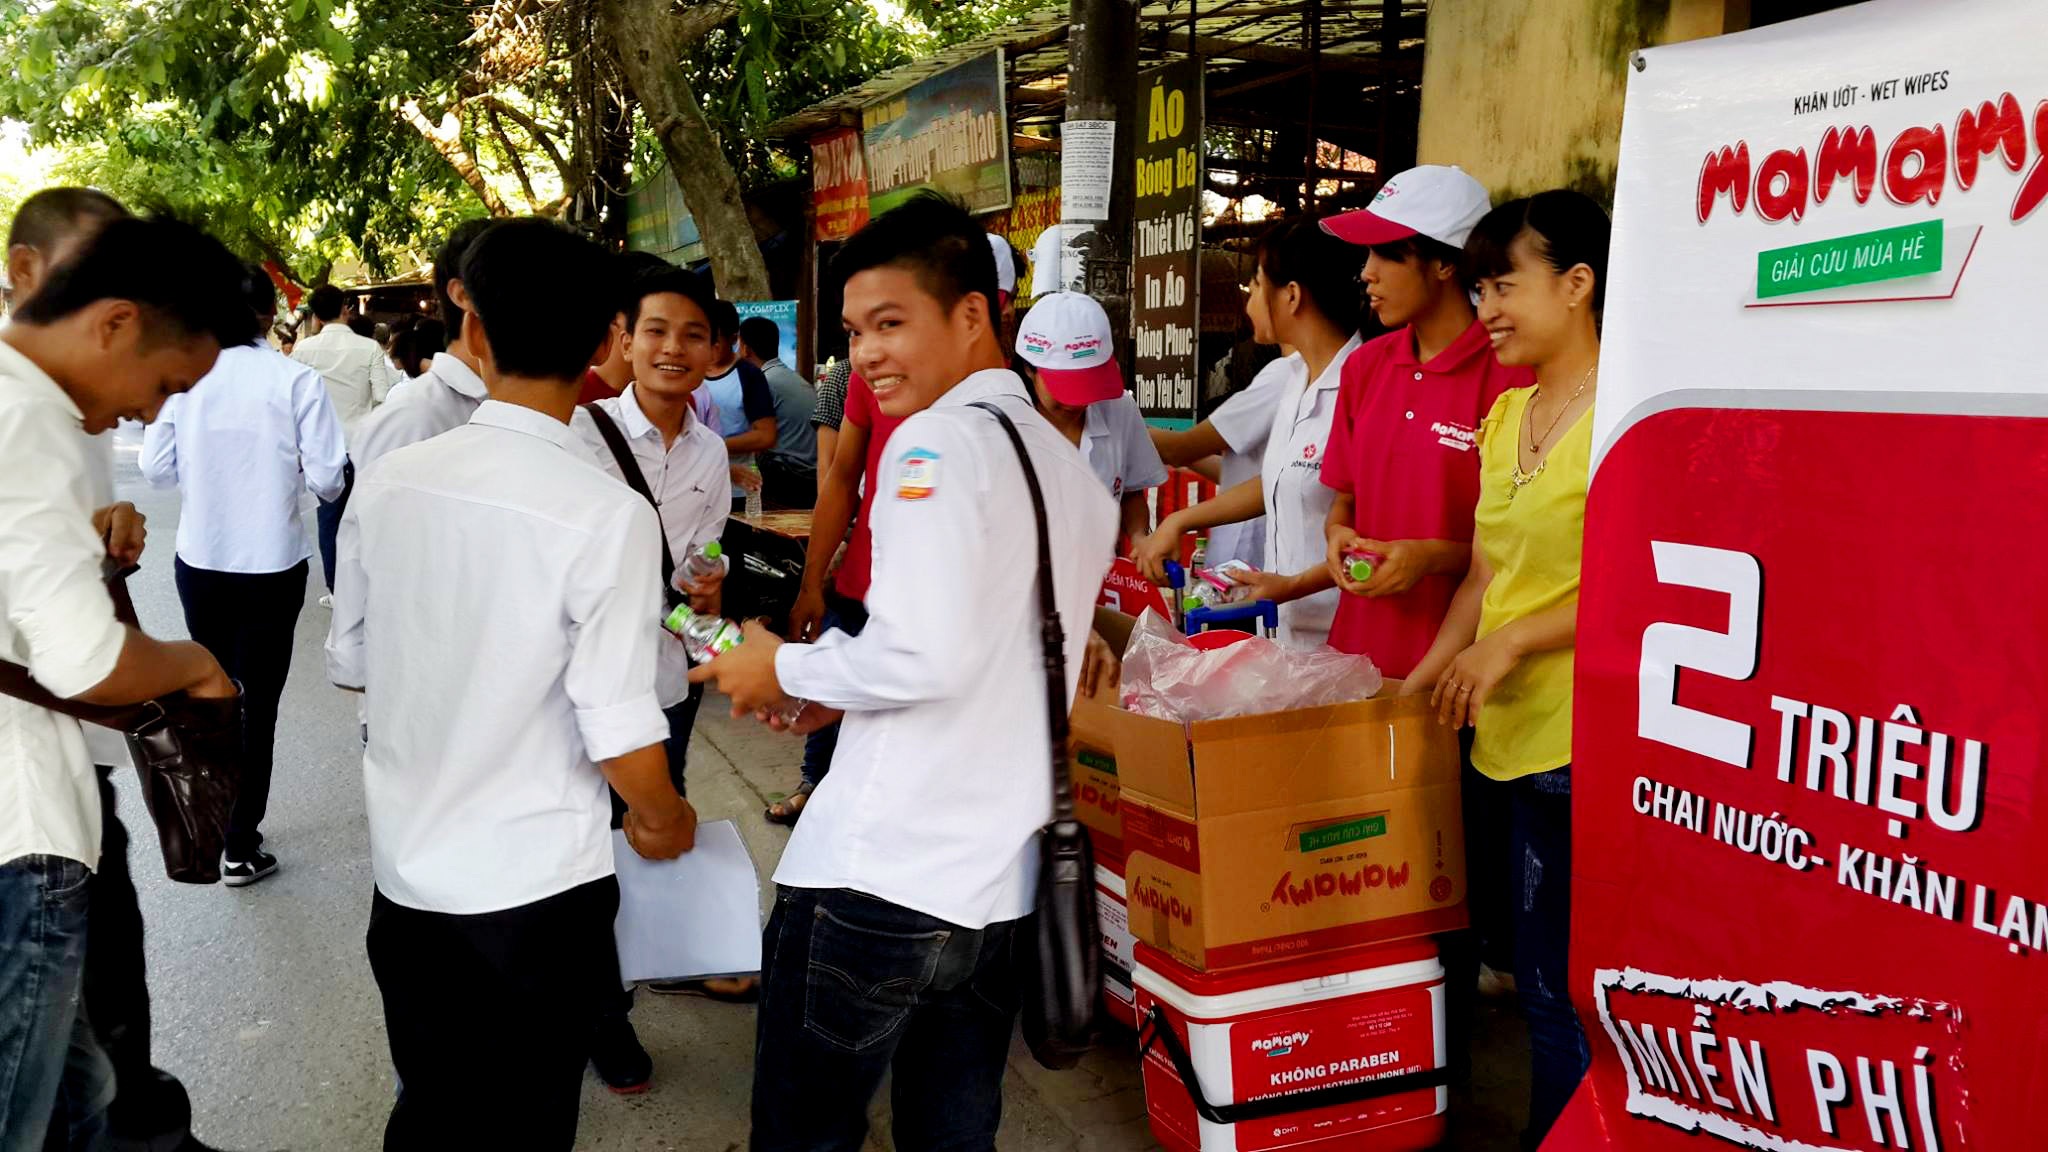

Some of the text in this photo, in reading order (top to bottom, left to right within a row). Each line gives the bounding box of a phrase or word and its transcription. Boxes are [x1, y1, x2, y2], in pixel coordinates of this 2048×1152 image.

[1148, 75, 1185, 143] Áo
[1793, 91, 1828, 116] KHĂN
[1870, 78, 1900, 102] WET
[1904, 70, 1949, 96] WIPES
[1136, 154, 1173, 198] Bóng
[1176, 143, 1196, 189] Đá
[1137, 209, 1173, 257] Thiết
[1175, 204, 1194, 252] Kế
[1771, 230, 1926, 282] GIẢI CỨU MÙA HÈ
[750, 303, 790, 313] COMPLEX
[1145, 273, 1160, 309] In
[1164, 264, 1185, 308] Áo
[1136, 320, 1193, 362] Đồng Phục
[1135, 367, 1192, 409] Theo Yêu Cầu
[1124, 576, 1148, 593] TẶNG
[1637, 539, 1761, 770] 2
[1770, 694, 1983, 839] TRIỆU
[1632, 776, 1706, 835] CHAI
[1837, 843, 1957, 921] KHĂN
[1270, 1050, 1400, 1086] KHÔNG PARABEN
[1620, 1003, 1940, 1152] MIỄN PHÍ
